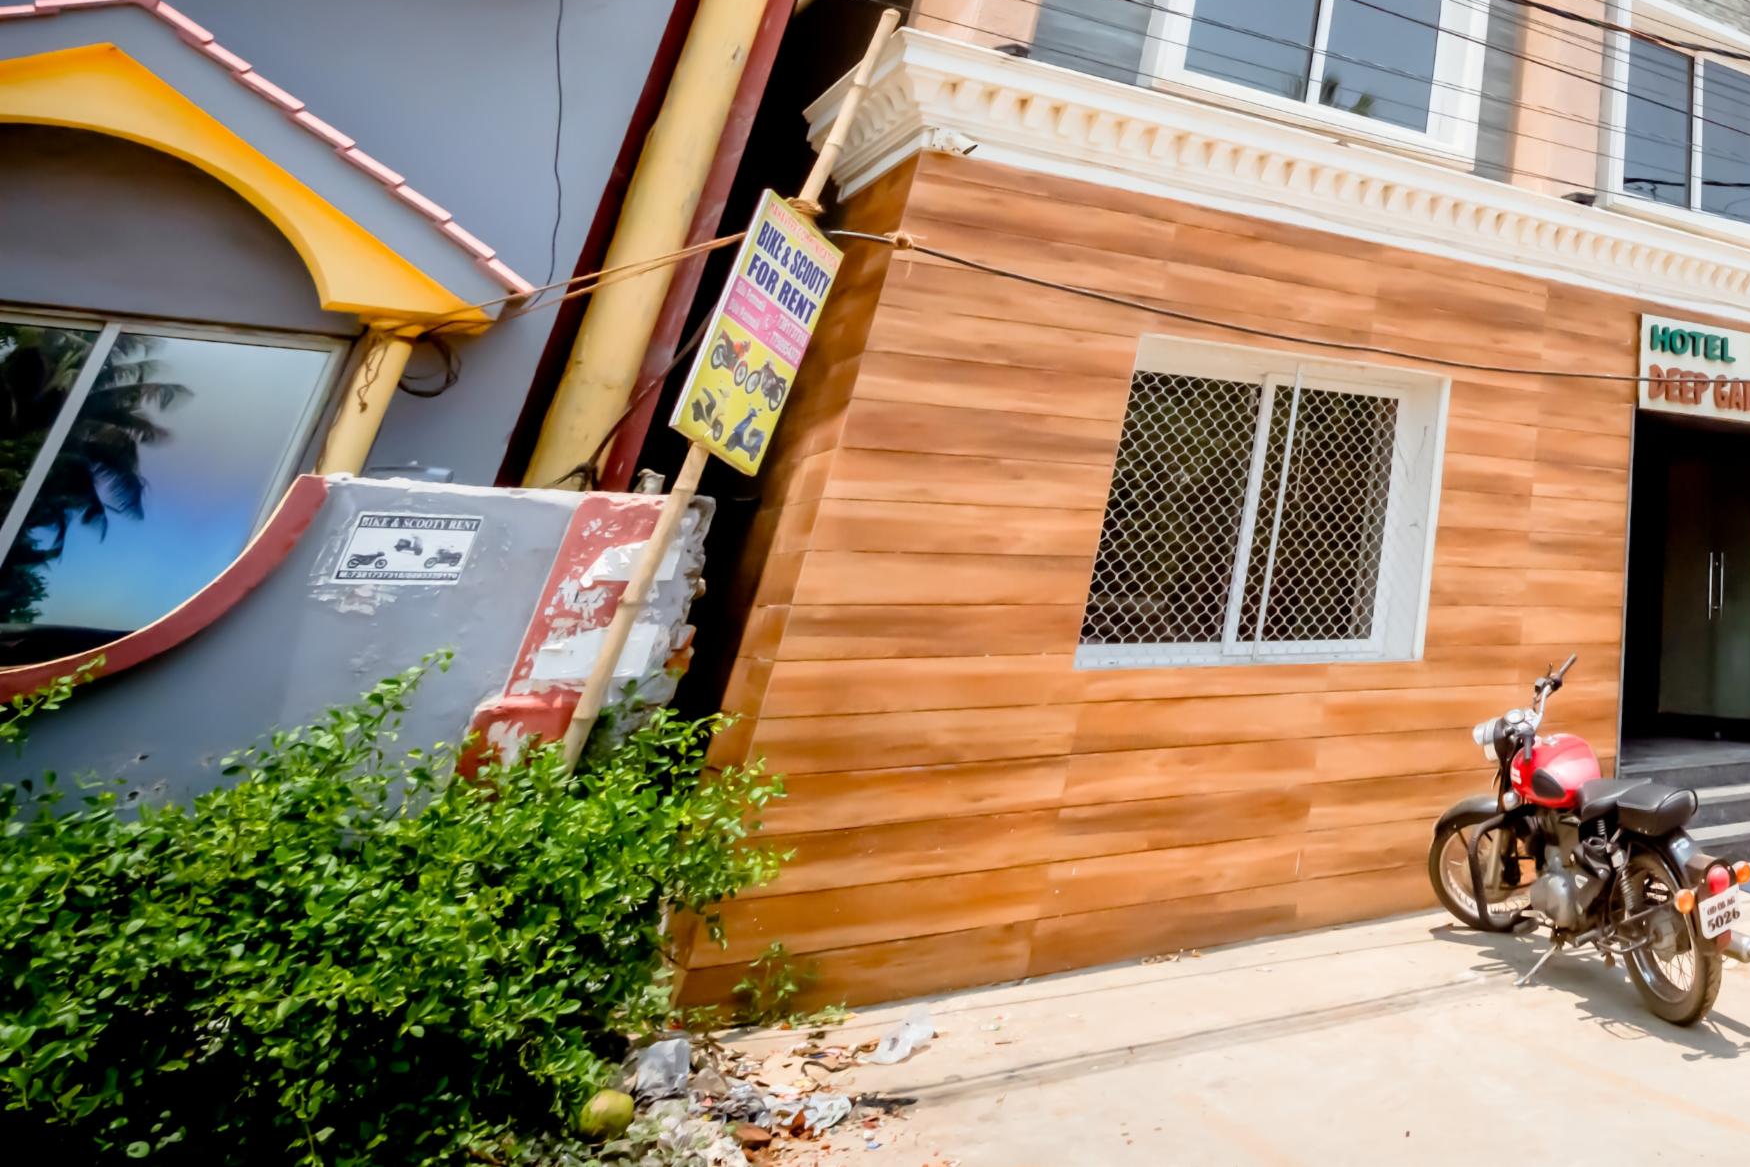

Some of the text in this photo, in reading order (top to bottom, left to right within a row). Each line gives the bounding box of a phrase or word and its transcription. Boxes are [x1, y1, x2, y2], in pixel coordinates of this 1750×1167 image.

[756, 221, 831, 300] BIKE & SCOOTY
[747, 253, 780, 295] FOR
[777, 280, 817, 324] RENT
[1650, 324, 1736, 363] HOTEL
[1648, 364, 1710, 405] DEEP
[360, 517, 480, 530] BIKE & SCOOTY RENT
[1707, 908, 1741, 931] 5026
